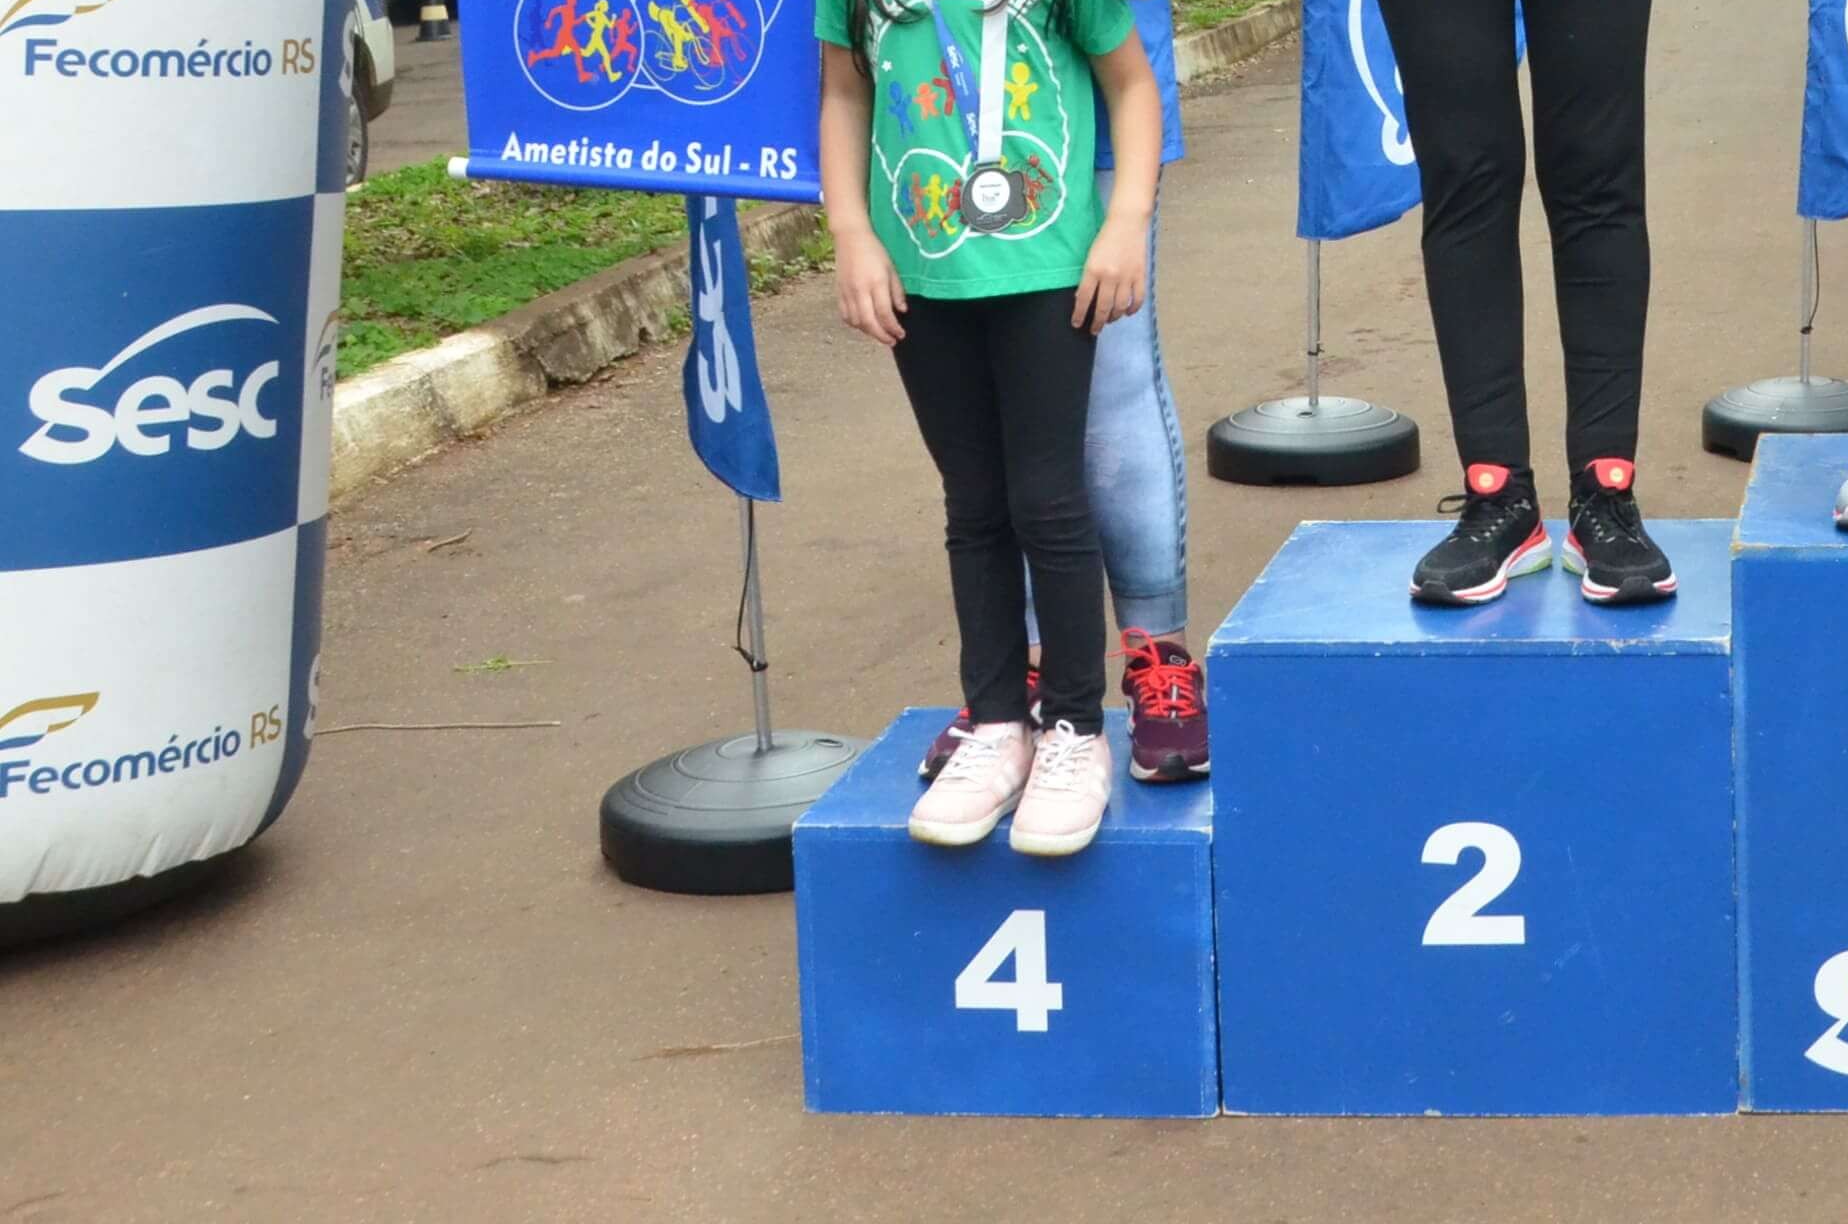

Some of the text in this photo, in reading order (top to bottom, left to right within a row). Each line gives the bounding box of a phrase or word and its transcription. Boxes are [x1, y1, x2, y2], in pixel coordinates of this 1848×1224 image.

[25, 37, 272, 78] Fecomércio
[282, 39, 315, 75] RS
[500, 132, 634, 168] Ametista
[640, 139, 674, 173] do
[685, 142, 731, 177] Sul
[760, 147, 798, 179] RS
[18, 359, 279, 465] Sesc
[0, 704, 282, 798] Fecomércio RS
[1421, 822, 1526, 946] 2
[954, 910, 1064, 1033] 4
